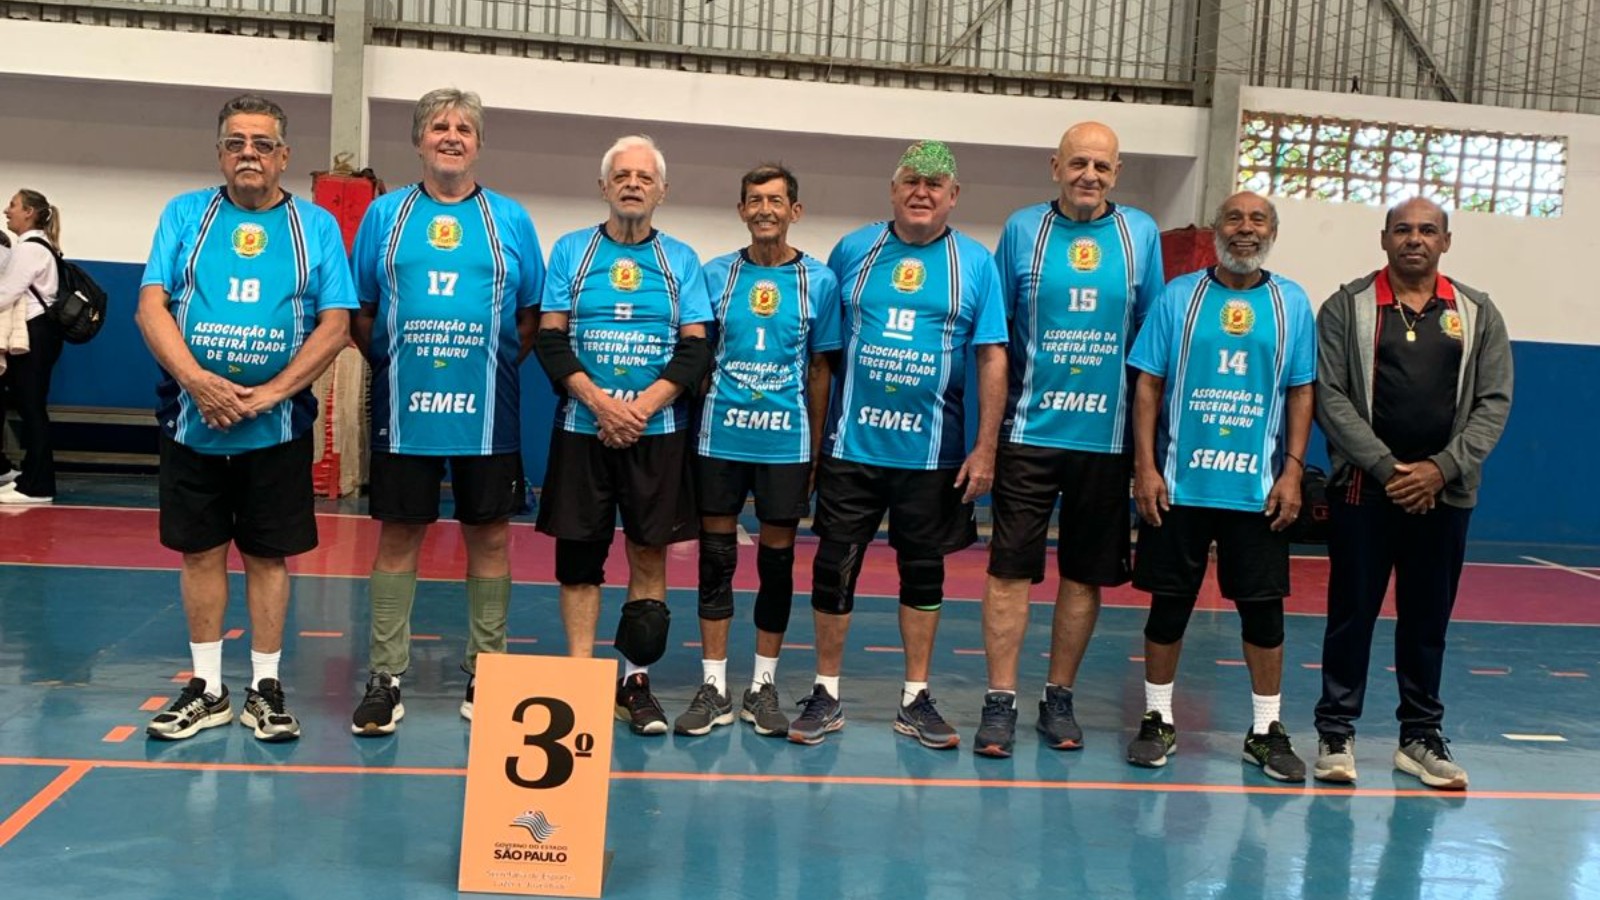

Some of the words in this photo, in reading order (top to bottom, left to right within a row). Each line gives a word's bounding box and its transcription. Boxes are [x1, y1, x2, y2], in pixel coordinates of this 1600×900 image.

[227, 277, 260, 303] 18
[427, 270, 459, 296] 17
[1067, 288, 1098, 312] 15
[194, 321, 265, 338] ASSOCIAÇÃO
[270, 328, 285, 340] DA
[404, 319, 465, 333] ASSOCIAÇÃO
[469, 322, 483, 333] DA
[190, 335, 247, 350] TERCEIRA
[251, 338, 286, 352] IDADE
[403, 333, 449, 345] TERCEIRA
[453, 334, 485, 347] IDADE
[583, 329, 644, 344] ASSOCIAÇÃO
[755, 327, 766, 350] 1
[1043, 329, 1100, 342] ASSOCIAÇÃO
[1104, 332, 1117, 342] DA
[416, 346, 429, 357] DE
[432, 346, 469, 358] BAURU
[583, 341, 629, 353] TERCEIRA
[633, 343, 661, 355] IDADE
[861, 344, 919, 360] ASSOCIAÇÃO
[922, 351, 935, 364] DA
[1041, 342, 1086, 353] TERCEIRA
[1089, 343, 1119, 354] IDADE
[206, 350, 222, 360] DE
[227, 351, 269, 365] BAURU
[596, 354, 609, 364] DE
[613, 355, 648, 366] BAURU
[858, 355, 902, 371] TERCEIRA
[905, 362, 936, 376] IDADE
[1053, 354, 1066, 364] DE
[1070, 354, 1103, 366] BAURU
[1217, 349, 1248, 376] 14
[869, 370, 881, 381] DE
[885, 372, 920, 386] BAURU
[408, 391, 477, 414] SEMEL
[1039, 390, 1108, 413] SEMEL
[1191, 388, 1252, 403] ASSOCIAÇÃO
[1188, 401, 1237, 413] TERCEIRA
[723, 407, 792, 431] SEMEL
[857, 405, 923, 433] SEMEL
[1203, 413, 1215, 424] DE
[1219, 414, 1253, 427] BAURU
[1189, 449, 1258, 473] SEMEL
[494, 847, 522, 861] SÃO
[524, 851, 567, 863] PAULO
